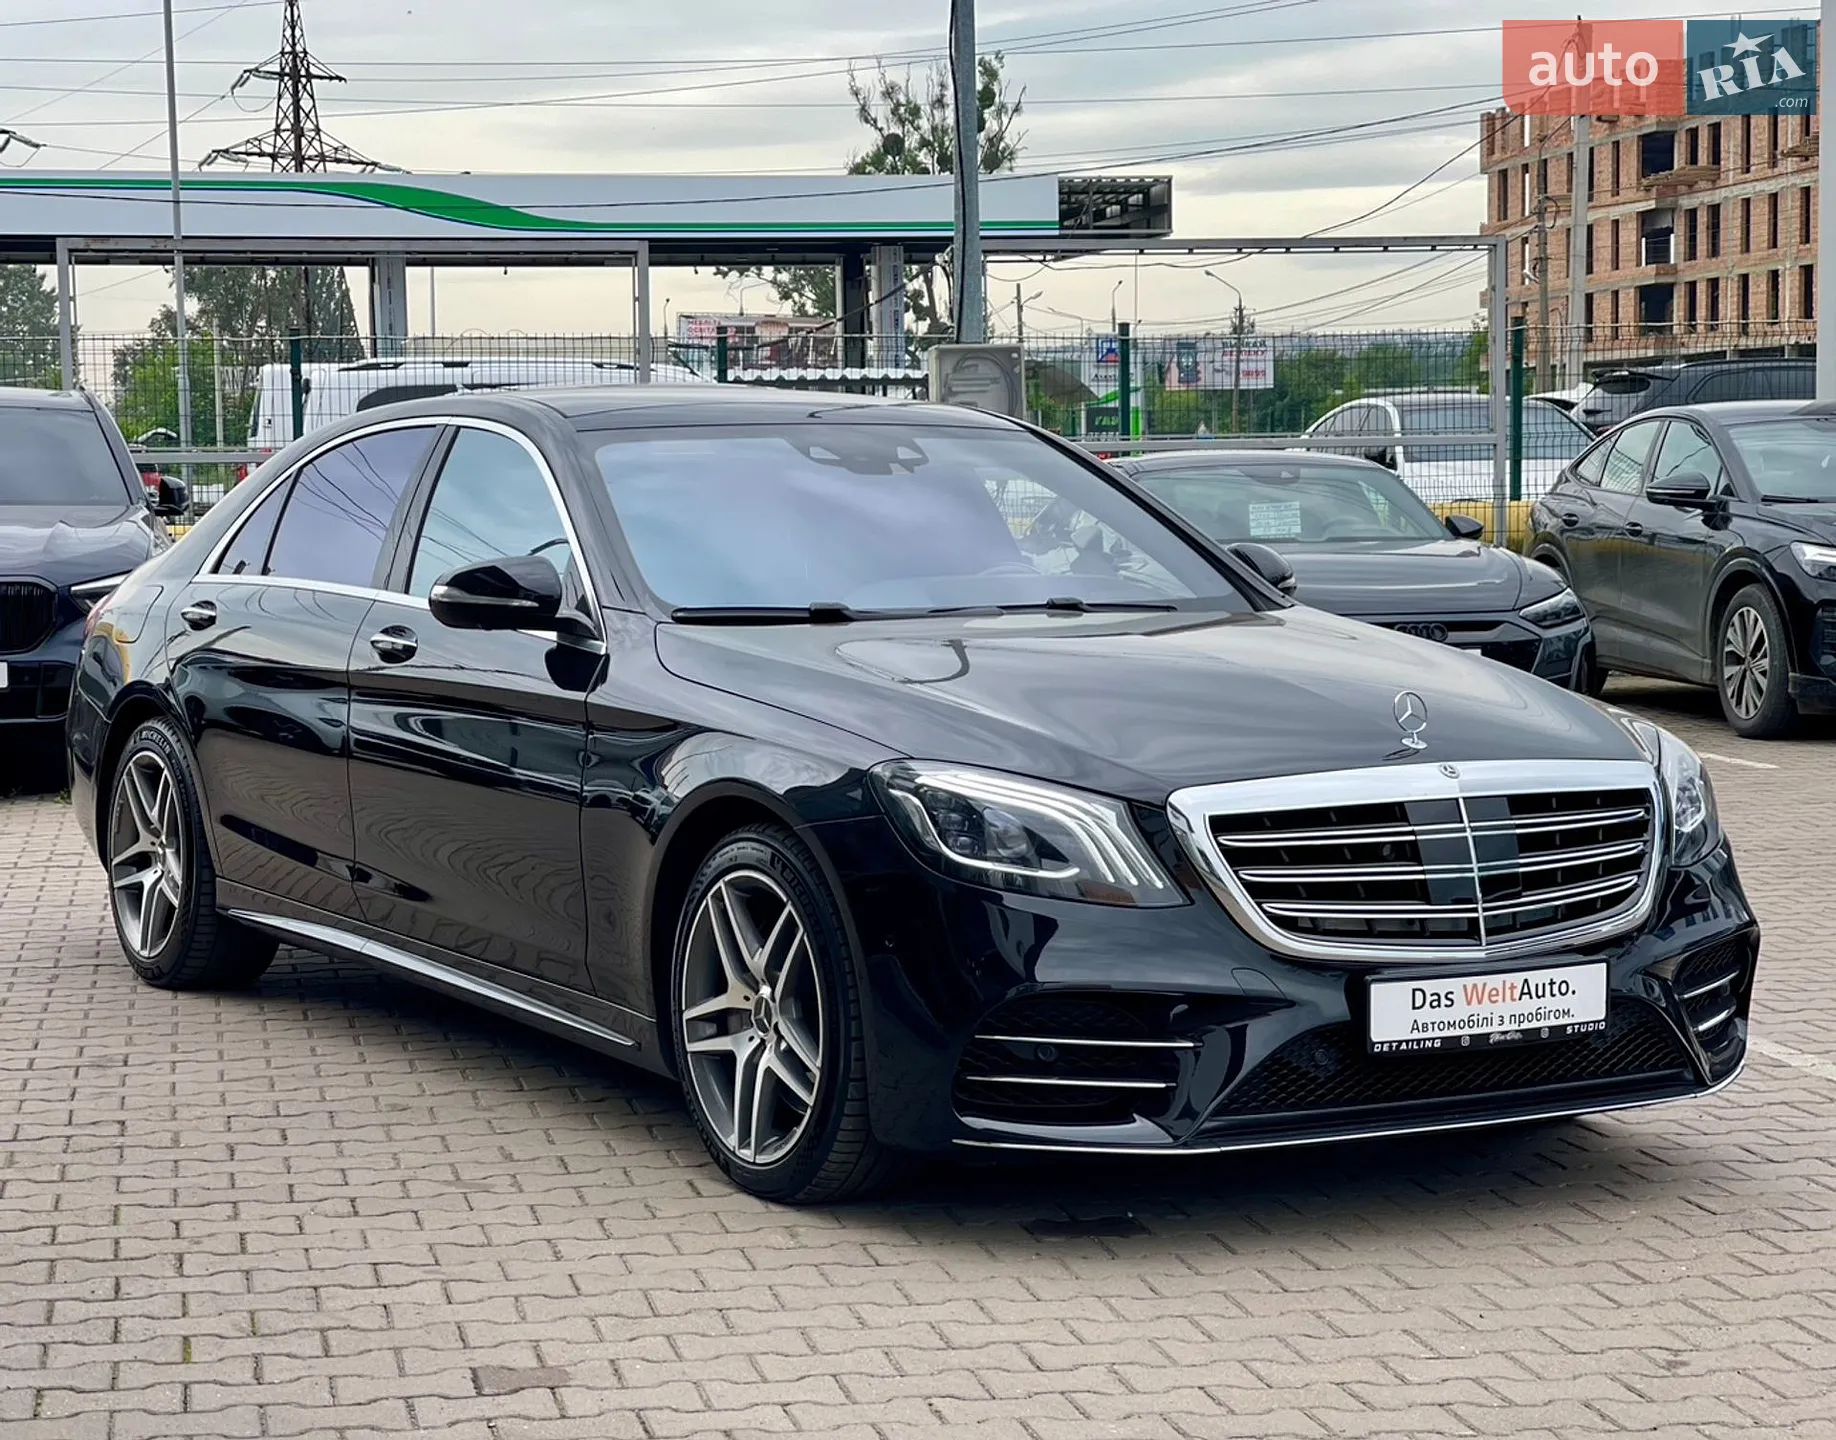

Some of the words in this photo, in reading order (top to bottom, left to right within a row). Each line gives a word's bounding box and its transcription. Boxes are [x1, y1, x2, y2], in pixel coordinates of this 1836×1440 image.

[1411, 987, 1455, 1011] Das
[1462, 978, 1577, 1007] WeltAuto.
[1410, 1012, 1494, 1035] Автомобілі
[1497, 1014, 1505, 1026] з
[1508, 1007, 1575, 1029] пробігом.
[1566, 1021, 1606, 1034] STUDIO
[1374, 1038, 1442, 1052] DETAILING
